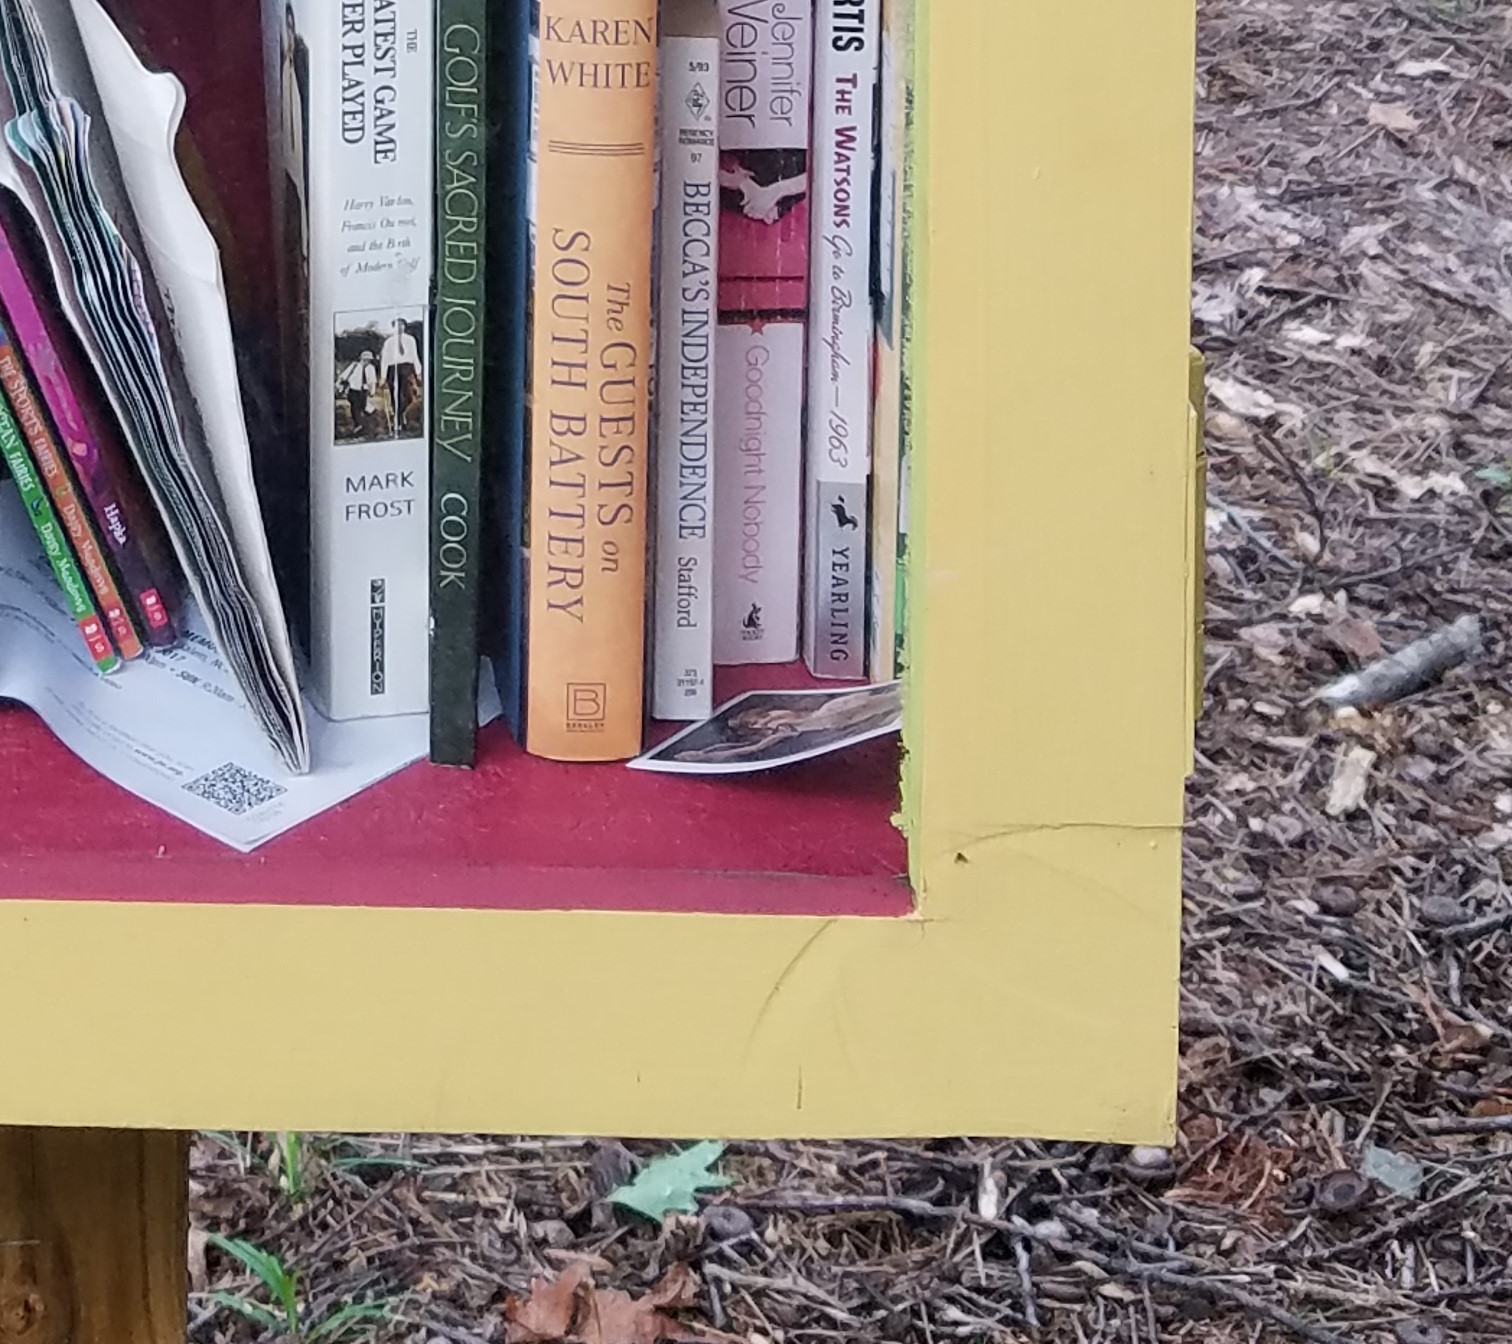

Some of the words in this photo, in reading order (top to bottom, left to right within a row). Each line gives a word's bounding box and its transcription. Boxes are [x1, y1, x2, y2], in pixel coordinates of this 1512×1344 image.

[406, 28, 418, 53] THE
[545, 15, 652, 47] KAREN
[546, 58, 651, 90] WHITE
[769, 2, 803, 128] Jennifer
[341, 43, 366, 145] PLAYED
[373, 72, 397, 164] GAME
[442, 23, 481, 140] GOLF'S
[834, 73, 858, 116] THE
[344, 197, 374, 211] Harry
[442, 144, 478, 286] SACRED
[833, 124, 858, 230] WATSONS
[347, 241, 366, 253] and
[368, 240, 383, 251] the
[680, 180, 712, 301] BECCA'S
[823, 234, 853, 262] Go
[831, 265, 845, 282] to
[550, 227, 591, 390] SOUTH
[606, 281, 630, 332] The
[7, 375, 42, 438] SPORTS
[35, 437, 59, 480] FAIRIES
[436, 297, 477, 464] JOURNEY
[677, 308, 710, 541] INDEPENDENCE
[739, 344, 770, 475] Goodnight
[346, 470, 415, 494] MARK
[597, 340, 638, 527] GUESTS
[9, 450, 35, 493] FAIRIES
[57, 556, 87, 615] Meadows
[104, 502, 128, 546] Hapka
[345, 498, 416, 523] FROST
[438, 491, 468, 590] COOK
[547, 411, 589, 623] BATTERY
[601, 539, 619, 574] on
[737, 481, 768, 586] Nobody
[676, 556, 699, 629] Stafford
[831, 546, 849, 663] YEARLING
